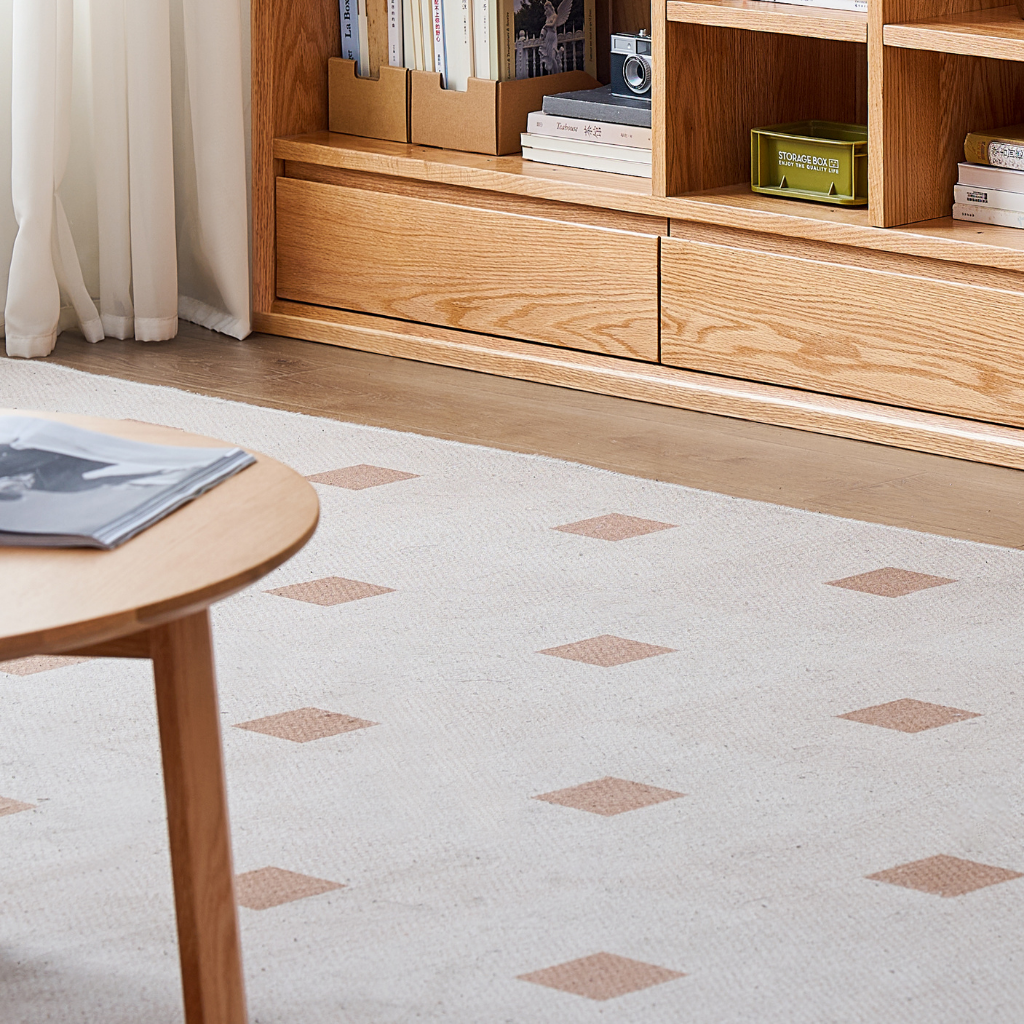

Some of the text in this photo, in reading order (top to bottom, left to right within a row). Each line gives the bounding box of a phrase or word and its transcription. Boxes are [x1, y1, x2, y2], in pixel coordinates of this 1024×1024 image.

[344, 23, 352, 38] La
[778, 150, 828, 167] STORAGE BOX
[806, 164, 827, 172] QUALITY
